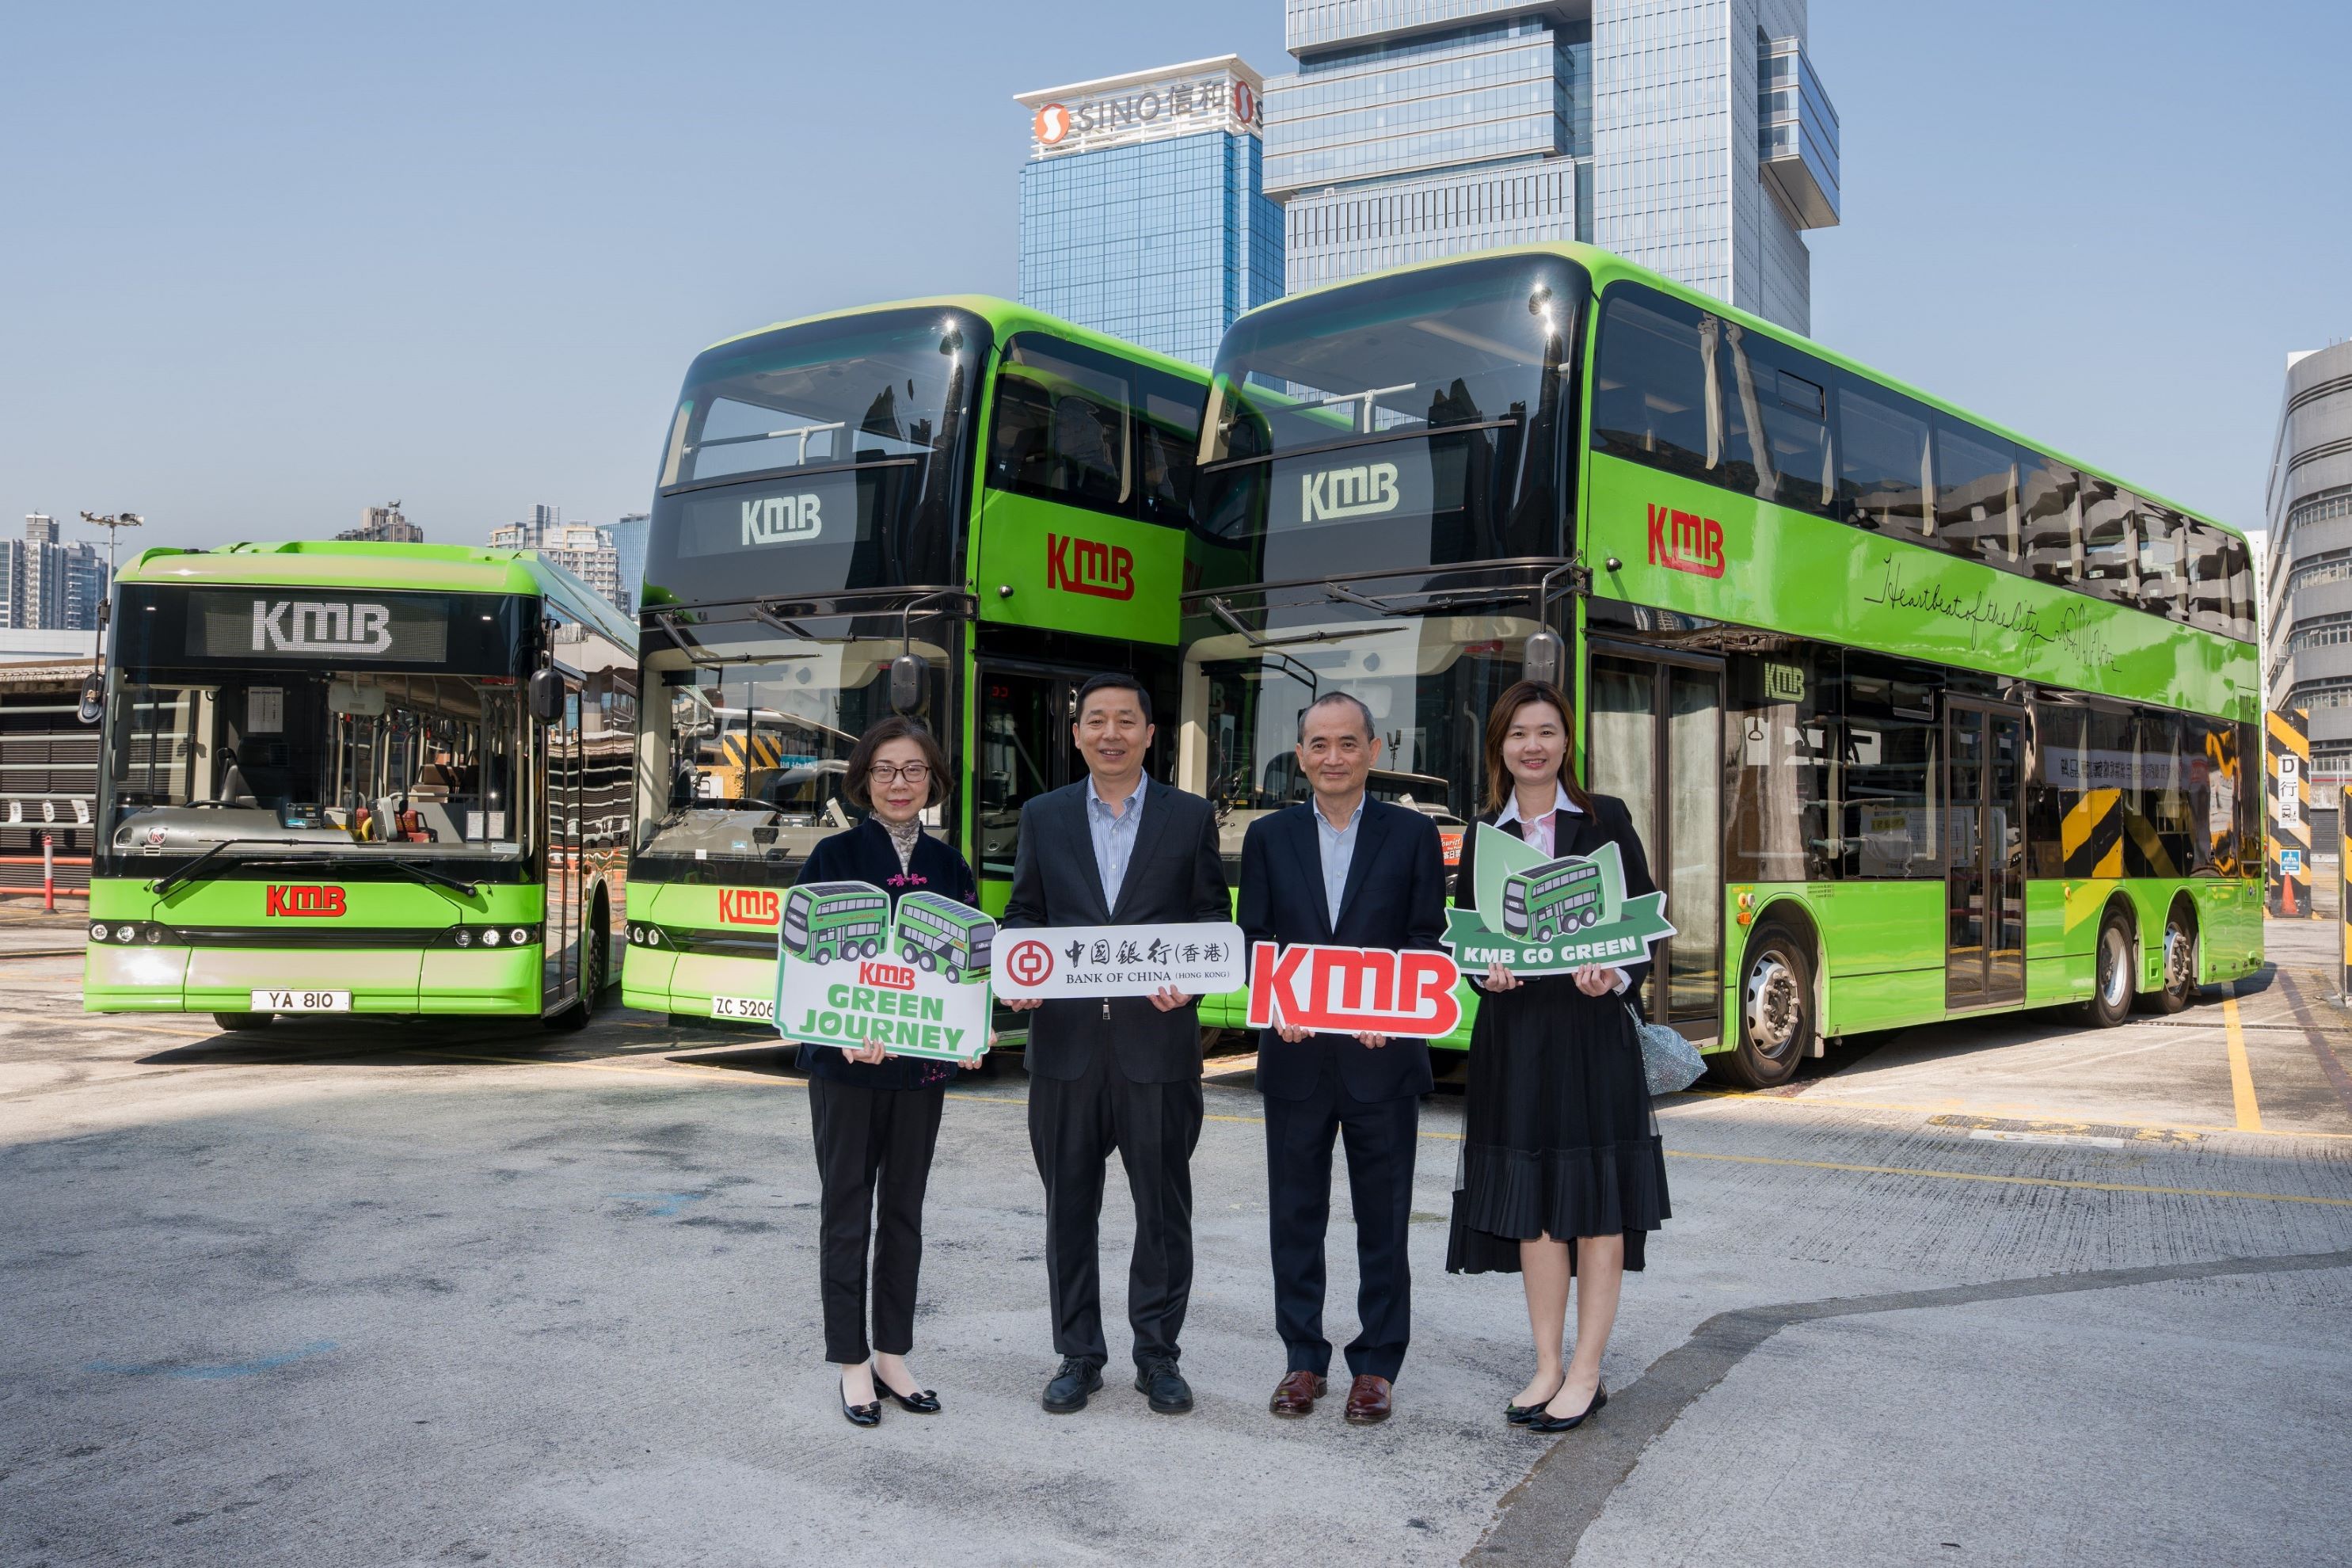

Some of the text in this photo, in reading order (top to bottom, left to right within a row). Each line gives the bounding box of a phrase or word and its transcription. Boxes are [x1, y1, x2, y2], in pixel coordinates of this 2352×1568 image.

[1076, 92, 1160, 132] SINO
[1166, 80, 1224, 116] 信和
[1303, 462, 1399, 522] KMB
[742, 493, 822, 546] KMB
[1648, 503, 1725, 579] KMB
[1048, 532, 1135, 601] KMB
[252, 600, 392, 653] KMB
[1764, 662, 1805, 702] KMB
[2279, 759, 2297, 797] D 行
[266, 885, 347, 917] KMB
[719, 889, 780, 926] KMB
[1064, 938, 1229, 969] 中國銀行(香港)
[1463, 936, 1638, 964] KMB GO GREEN
[859, 961, 915, 991] KMB
[1066, 973, 1102, 984] BANK
[1106, 972, 1124, 983] OF
[1128, 971, 1172, 983] CHINA
[1175, 971, 1201, 980] (HONG
[1250, 945, 1459, 1035] KMB
[269, 993, 333, 1008] YA 810
[716, 998, 774, 1018] ZC 5206
[828, 984, 944, 1022] GREEN
[799, 1010, 965, 1051] JOURNEY
